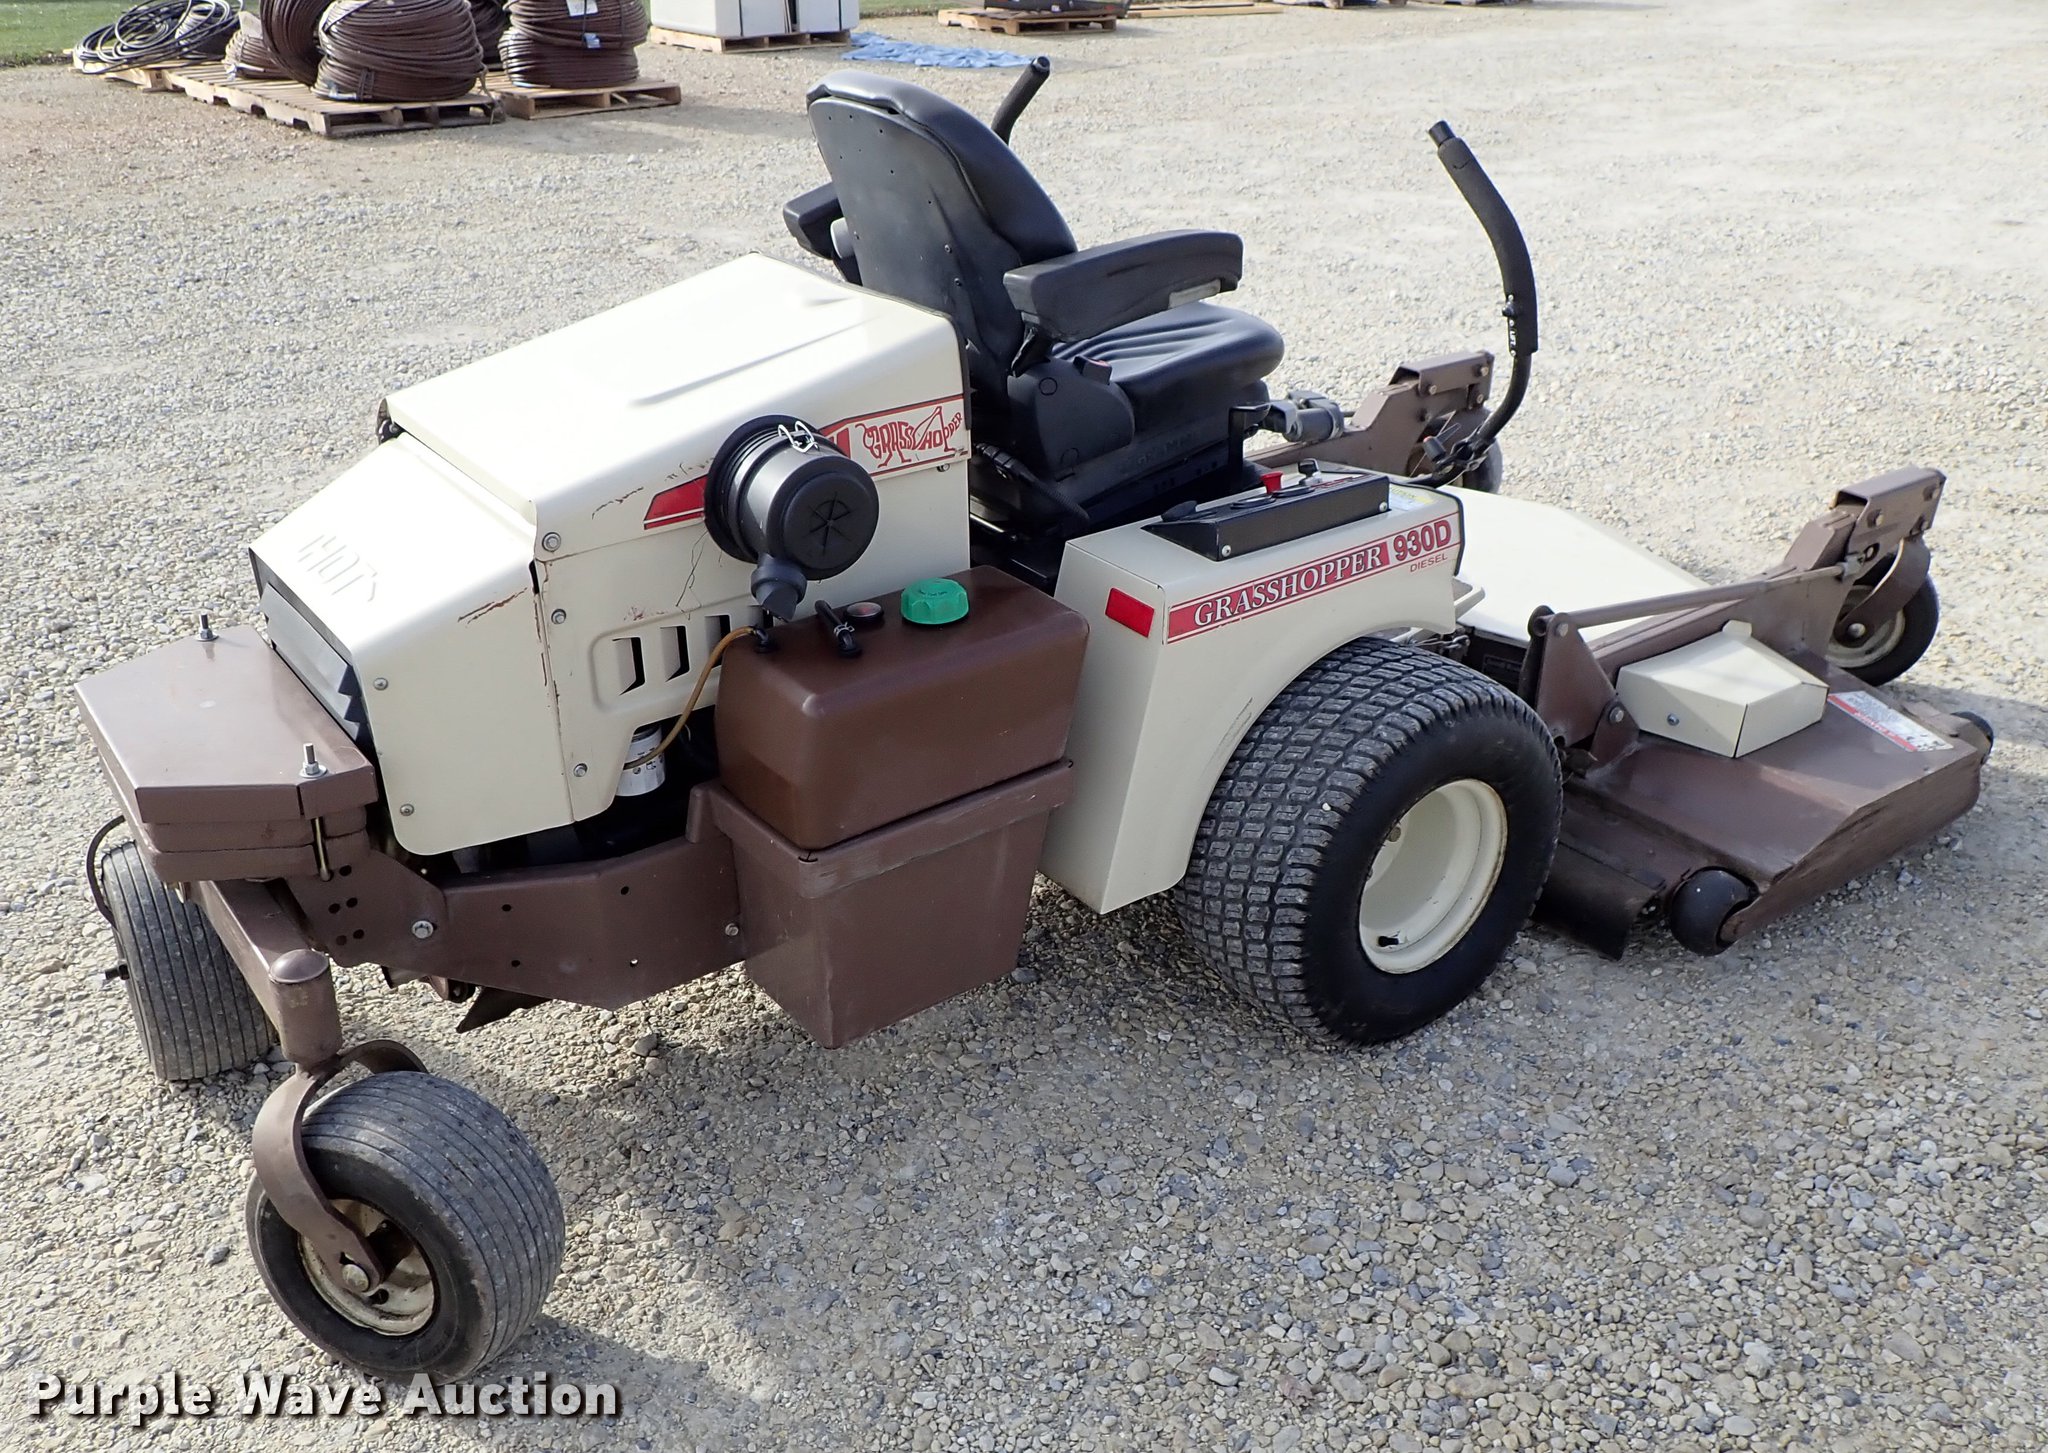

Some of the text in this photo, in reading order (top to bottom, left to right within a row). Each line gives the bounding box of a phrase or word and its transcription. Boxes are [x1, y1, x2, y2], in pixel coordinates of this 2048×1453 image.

[1193, 519, 1452, 627] GRASSHOPPER 930D
[1409, 552, 1448, 573] DIESEL
